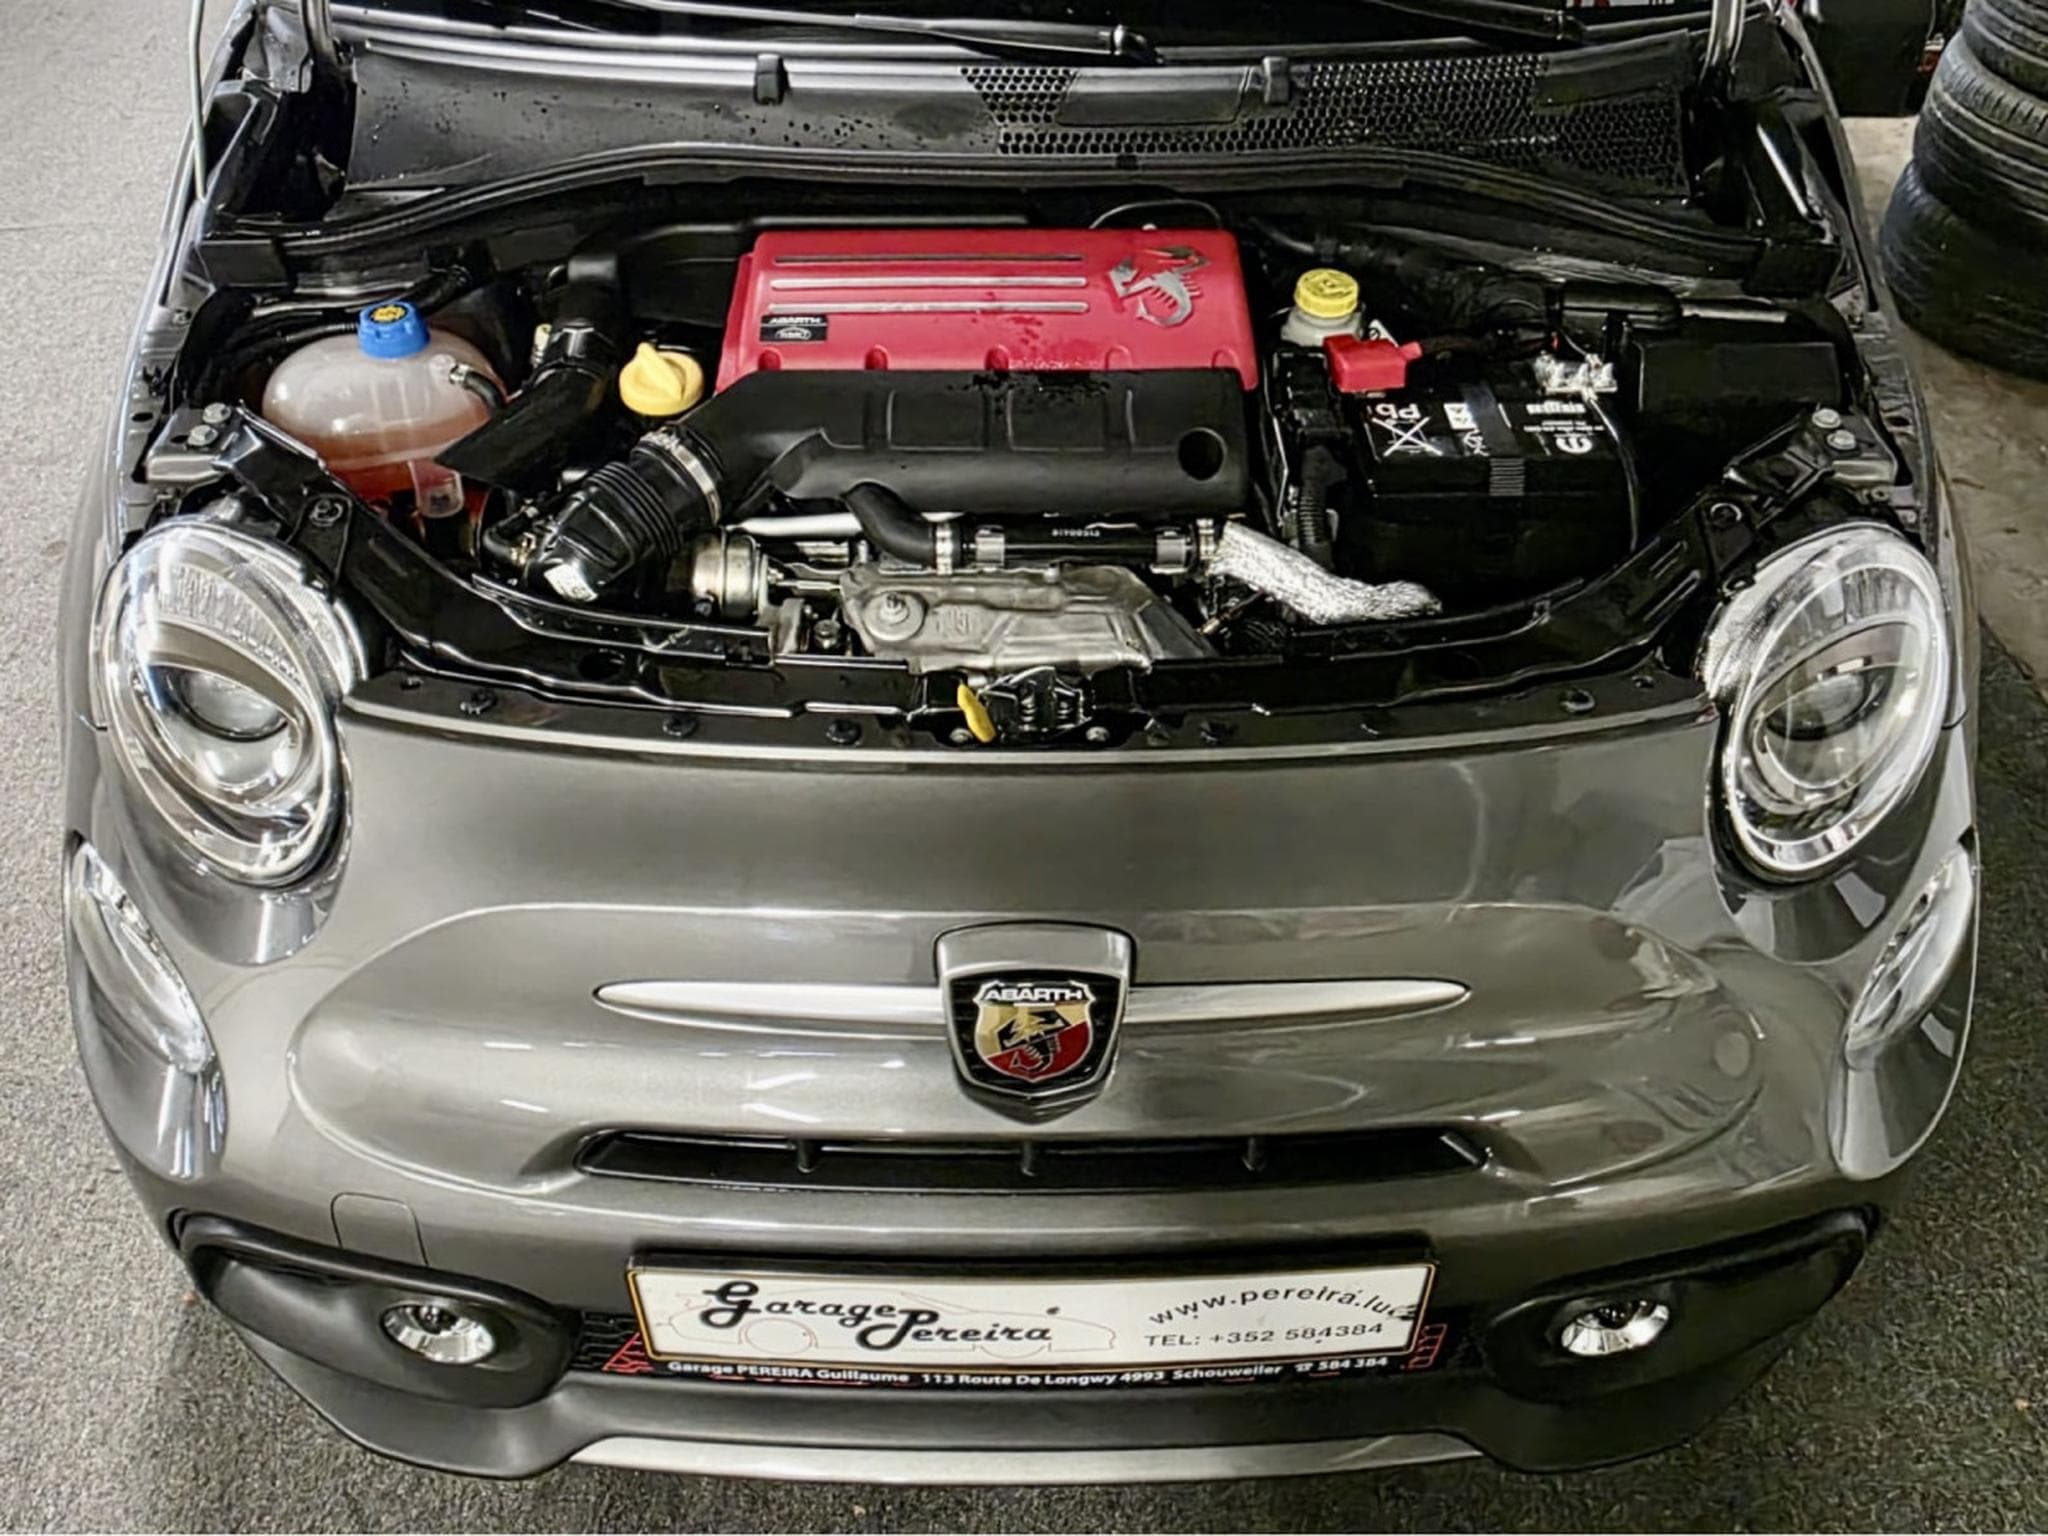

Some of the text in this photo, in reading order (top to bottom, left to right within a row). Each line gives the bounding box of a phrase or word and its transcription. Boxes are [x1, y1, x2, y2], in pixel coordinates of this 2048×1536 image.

[983, 987, 1083, 1001] ABARTH
[700, 1280, 897, 1329] Garage
[1149, 1285, 1392, 1325] www.pereira.lu
[855, 1308, 1053, 1351] Pereira
[1145, 1322, 1384, 1347] TEL: +352 584384
[668, 1356, 1388, 1386] Garage PEREIRA Guillaume 113 Route De Longwy 4993 Schouweiler 584 384
